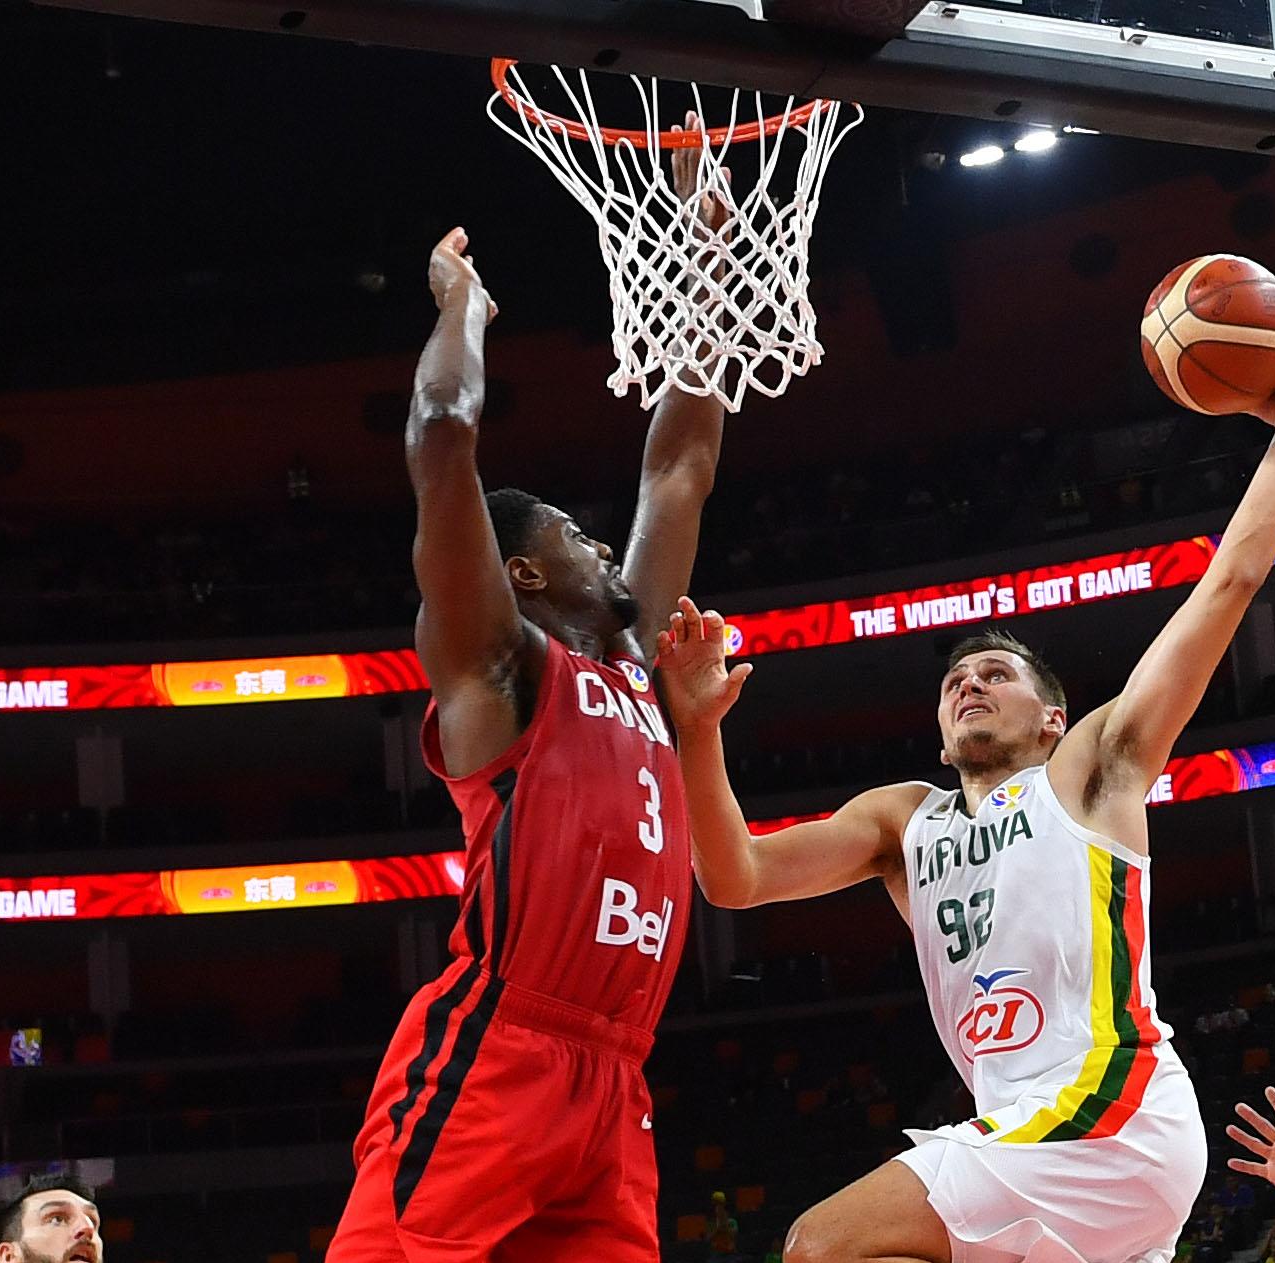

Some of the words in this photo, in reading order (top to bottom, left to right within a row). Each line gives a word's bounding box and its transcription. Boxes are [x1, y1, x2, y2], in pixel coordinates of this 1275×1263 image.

[850, 607, 896, 636] THE
[902, 584, 1015, 629] WORLD'S
[1027, 576, 1074, 609] GOT
[1078, 562, 1152, 600] GAME
[235, 670, 286, 696] 东莞
[638, 767, 665, 854] 3
[244, 877, 295, 903] 东莞
[937, 888, 995, 965] 92
